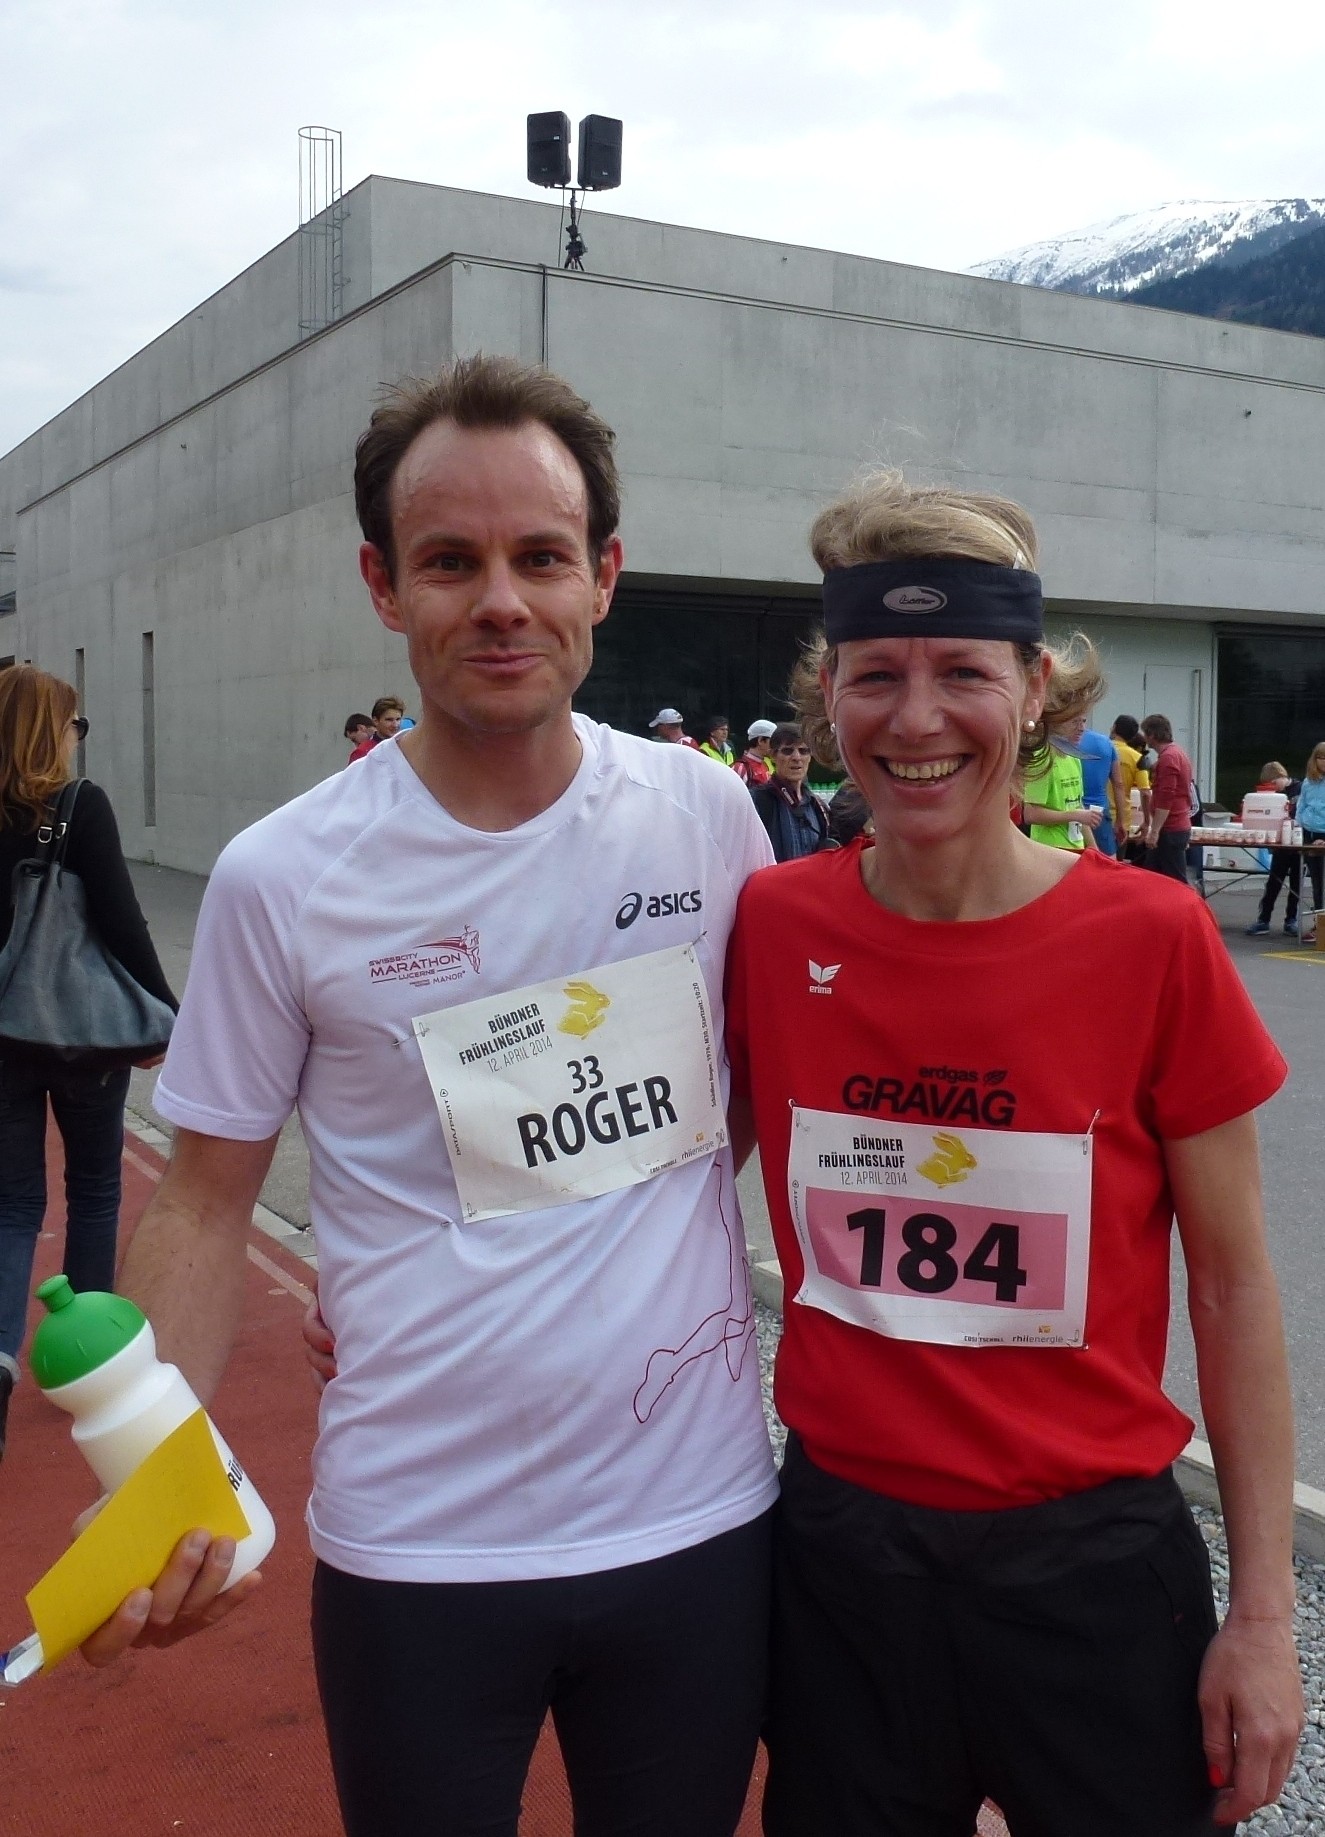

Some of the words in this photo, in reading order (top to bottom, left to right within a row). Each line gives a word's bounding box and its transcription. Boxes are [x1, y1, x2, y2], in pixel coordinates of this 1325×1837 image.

[646, 890, 702, 918] asics
[370, 953, 462, 977] MARATHON
[398, 969, 436, 980] LUCERNE
[692, 982, 702, 999] 10:20
[809, 985, 832, 994] erima
[488, 1003, 540, 1034] BÜNDNER
[459, 1019, 546, 1065] FRÜHLINGSLAUF
[487, 1058, 503, 1073] 12.
[503, 1046, 530, 1067] APRIL
[529, 1035, 553, 1057] 2014
[566, 1055, 604, 1094] 33
[918, 1066, 978, 1083] erdgas
[842, 1074, 1017, 1126] GRAVAG
[517, 1075, 678, 1168] ROGER
[853, 1134, 904, 1151] BÜNDNER
[818, 1151, 905, 1168] FRÜHLINGSLAUF
[841, 1172, 854, 1185] 12.
[856, 1171, 882, 1185] APRIL
[884, 1171, 908, 1185] 2014
[846, 1207, 1027, 1303] 184
